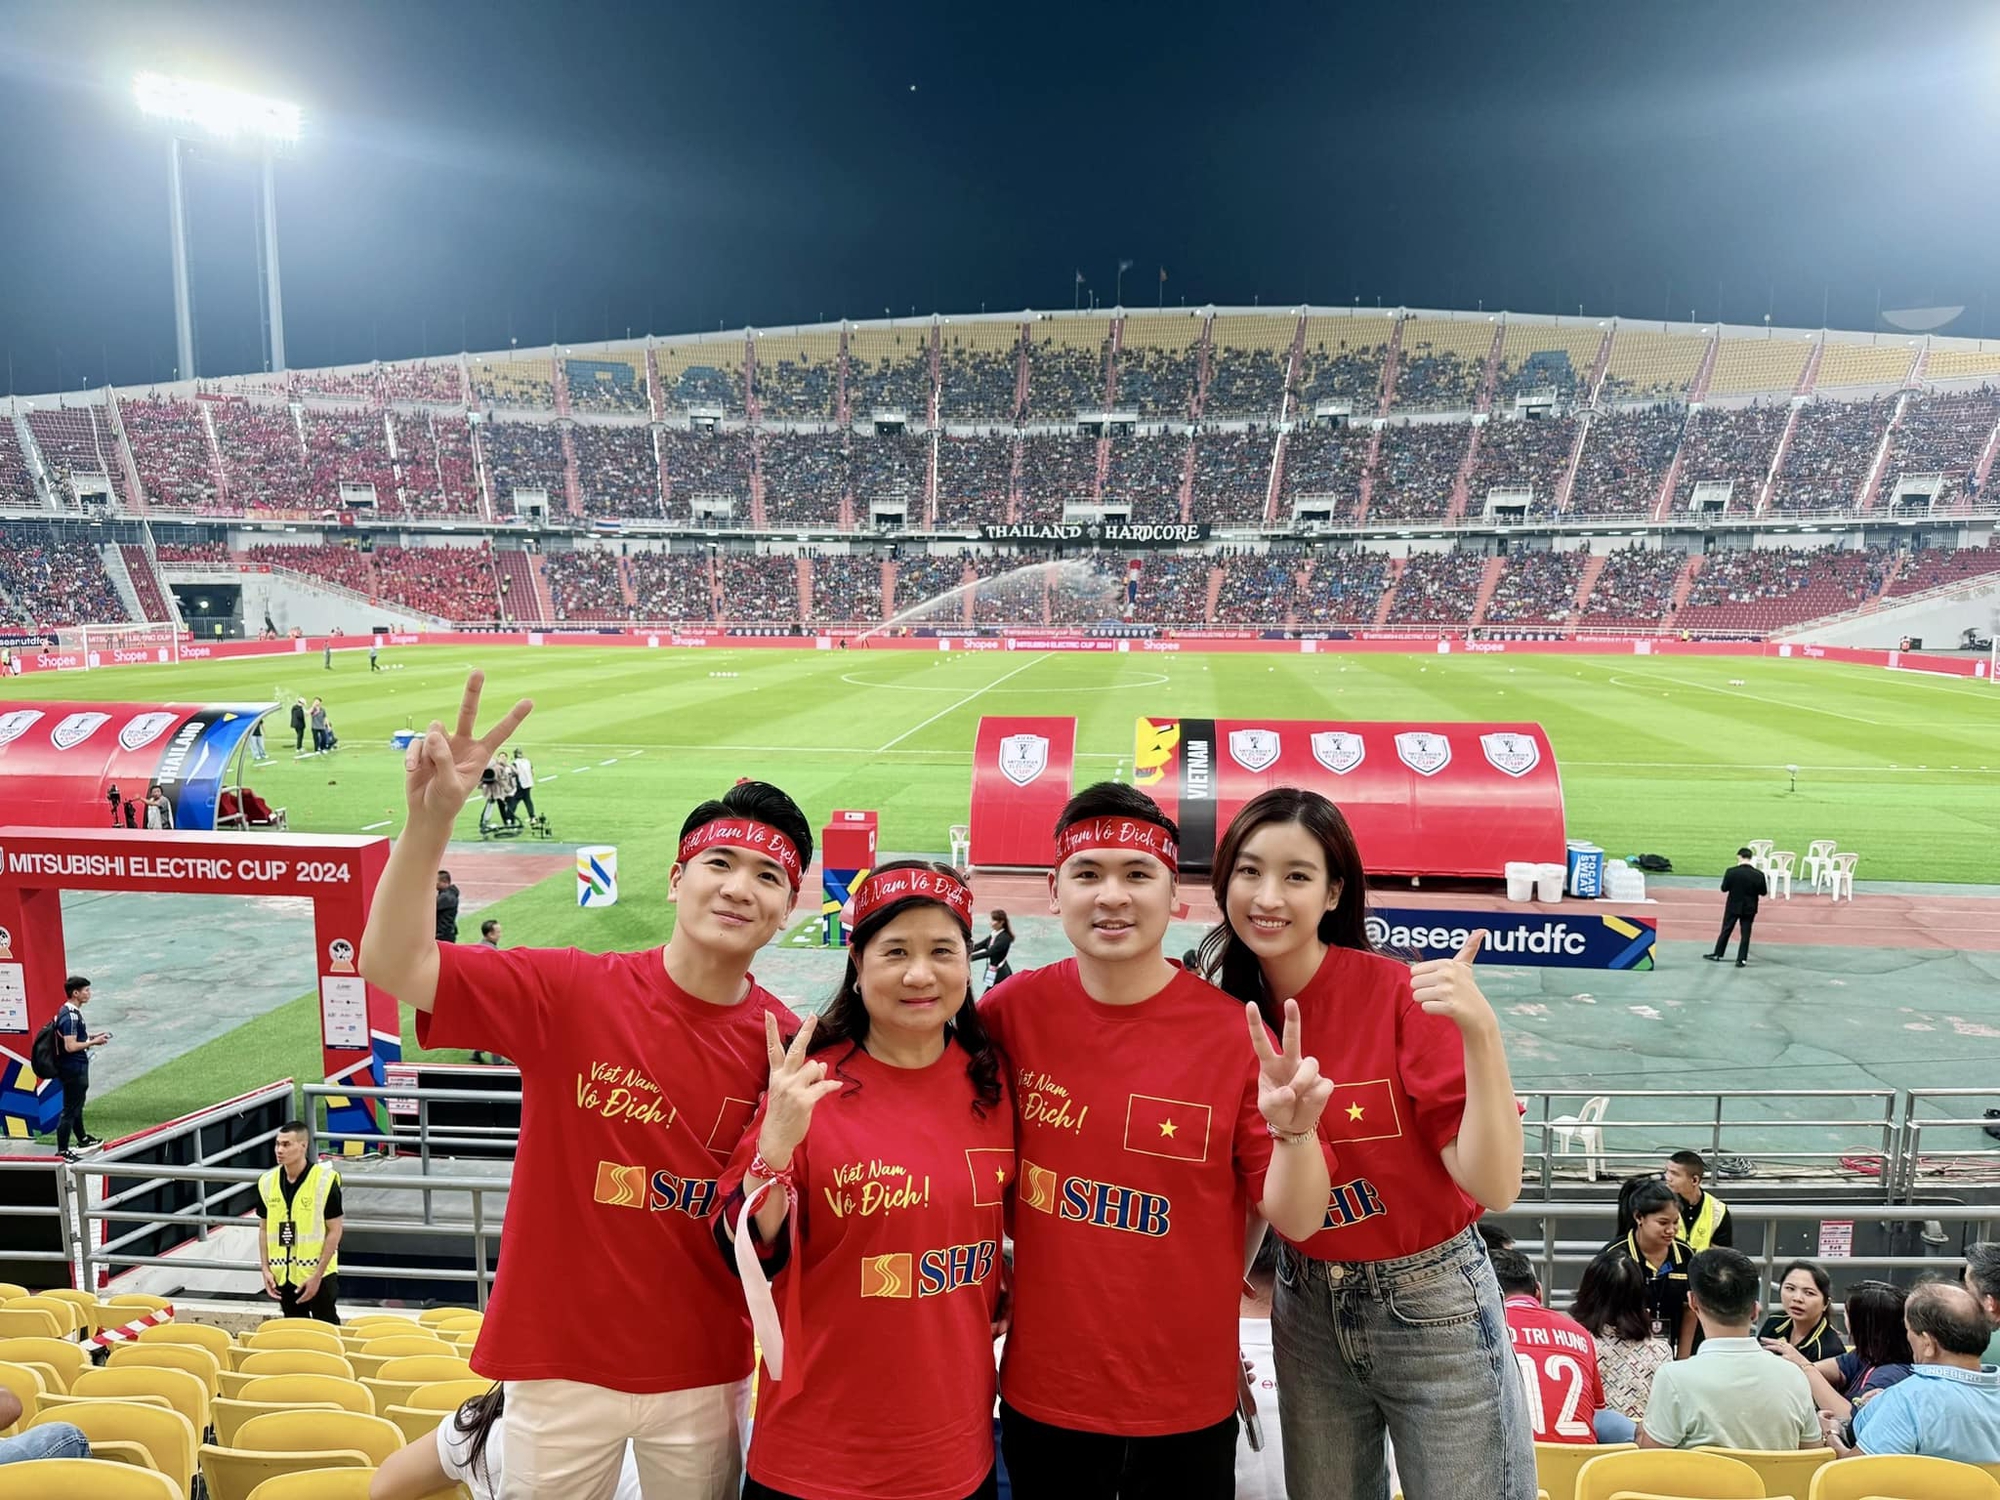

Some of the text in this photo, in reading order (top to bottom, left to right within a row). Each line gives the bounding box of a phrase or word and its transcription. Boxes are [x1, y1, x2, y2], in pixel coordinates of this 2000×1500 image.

[986, 524, 1199, 542] THAILAND HARDCORE
[114, 650, 148, 664] Shopee
[180, 645, 211, 660] Shopee
[963, 639, 998, 650] Shopee
[1080, 641, 1096, 649] CUP
[1143, 640, 1180, 652] Shopee
[1465, 641, 1505, 653] Shopee
[37, 655, 77, 670] Shopee
[156, 722, 206, 786] THAILAND
[1187, 740, 1209, 800] VIETNAM
[703, 822, 743, 843] Nam
[745, 823, 768, 843] Vô
[1095, 819, 1115, 842] Vô
[1118, 822, 1155, 847] Địch
[9, 853, 350, 883] MITSUBISHI ELECTRIC CUP 2024
[1580, 854, 1588, 893] SWEAT
[1588, 855, 1597, 897] POCARI
[871, 878, 908, 902] Nam
[911, 871, 931, 890] Vô
[577, 1073, 602, 1109] Vô
[591, 1061, 661, 1093] Việt Nam
[1034, 1074, 1070, 1098] Nam
[833, 1158, 906, 1188] Việt Nam
[650, 1169, 718, 1219] SH
[824, 1187, 857, 1218] Vô
[1059, 1176, 1171, 1238] SHB
[1319, 1177, 1387, 1230] HB
[918, 1240, 997, 1298] SHB
[1521, 1328, 1550, 1345] TRI
[1551, 1328, 1589, 1354] HUNG
